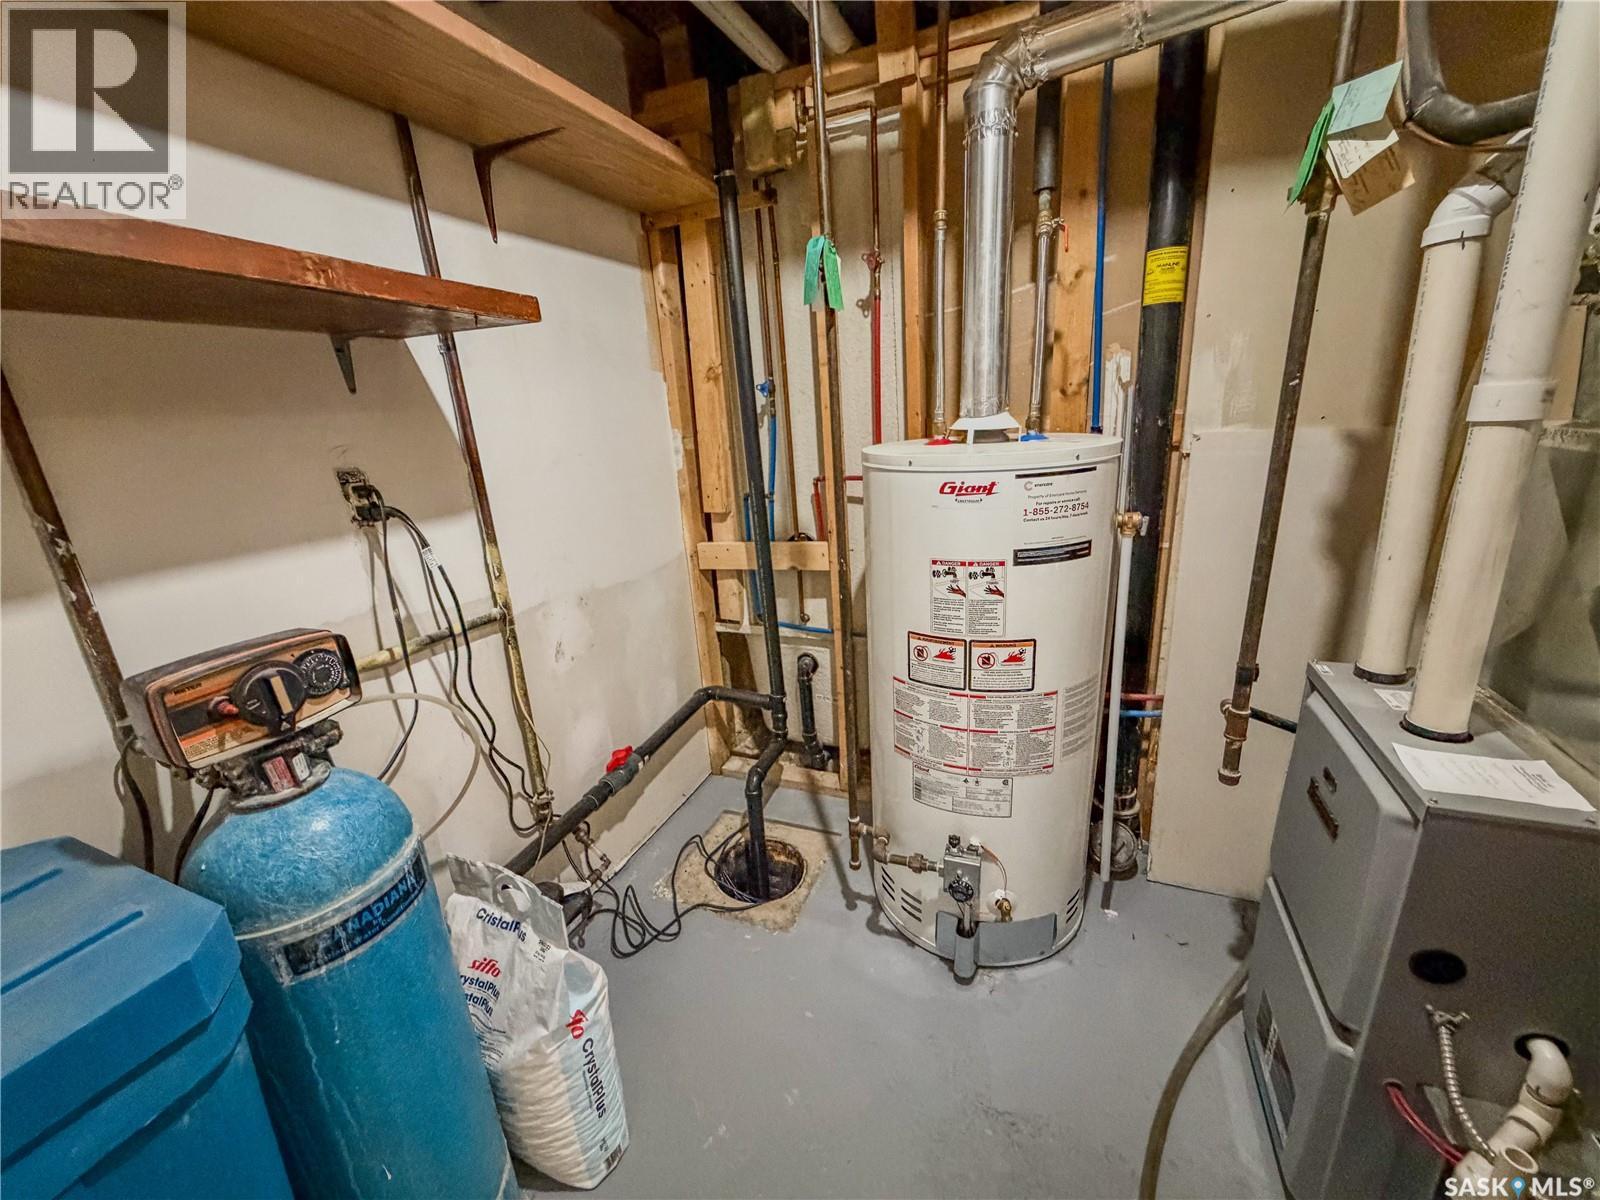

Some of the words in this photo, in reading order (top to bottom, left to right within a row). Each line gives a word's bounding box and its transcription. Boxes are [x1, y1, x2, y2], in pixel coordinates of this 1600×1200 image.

[938, 481, 999, 496] Giant
[1023, 502, 1089, 516] 1-855-272-8754
[476, 908, 527, 942] CristalPus
[582, 1037, 607, 1119] CrystalPlus
